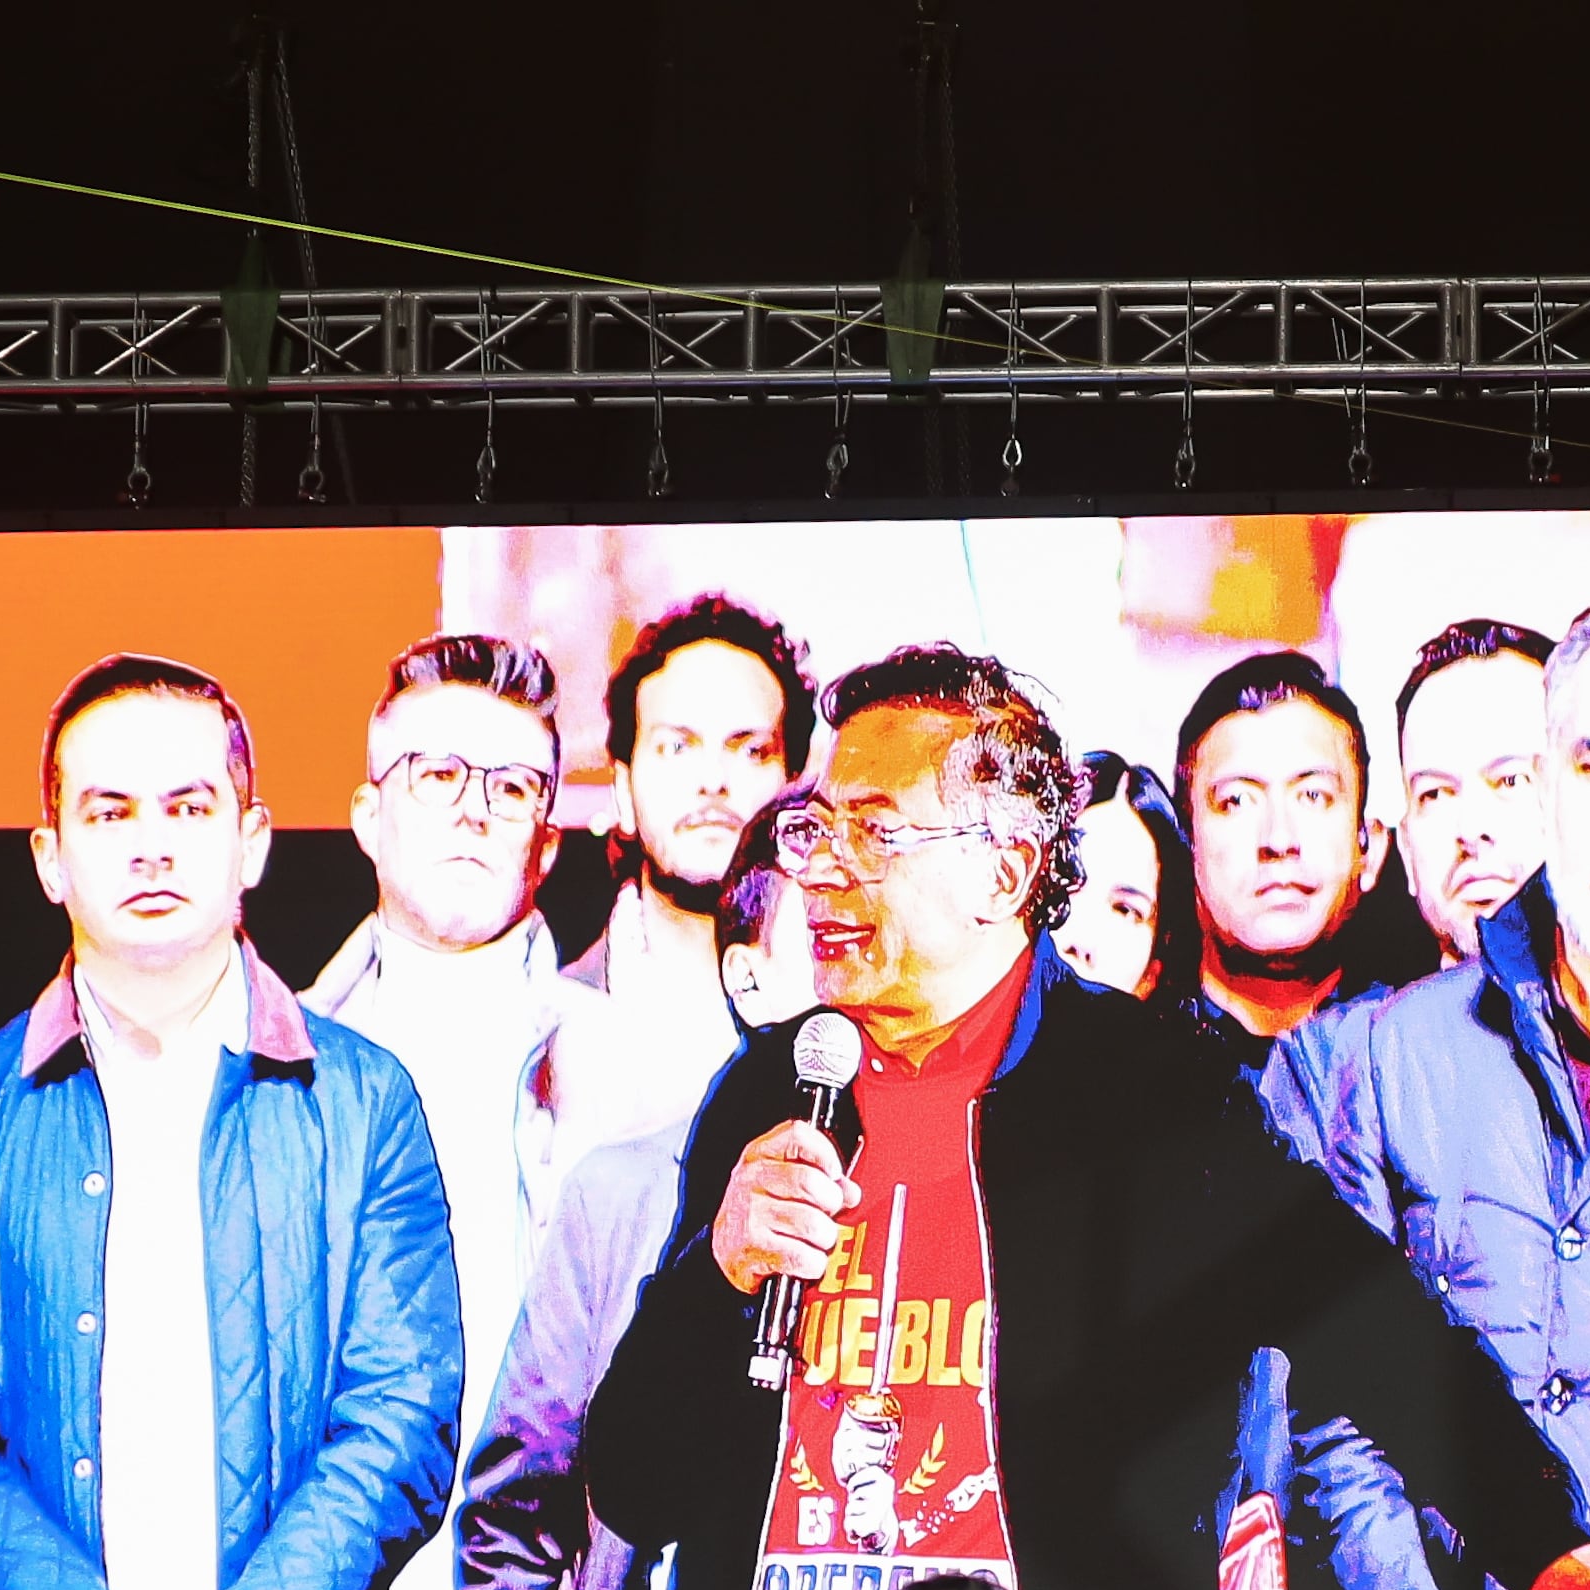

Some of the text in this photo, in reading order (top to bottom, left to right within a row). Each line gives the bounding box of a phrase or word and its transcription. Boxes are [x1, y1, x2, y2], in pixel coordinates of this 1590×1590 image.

[818, 1221, 873, 1294] EL
[799, 1298, 987, 1387] UEBLO
[798, 1496, 837, 1547] ES
